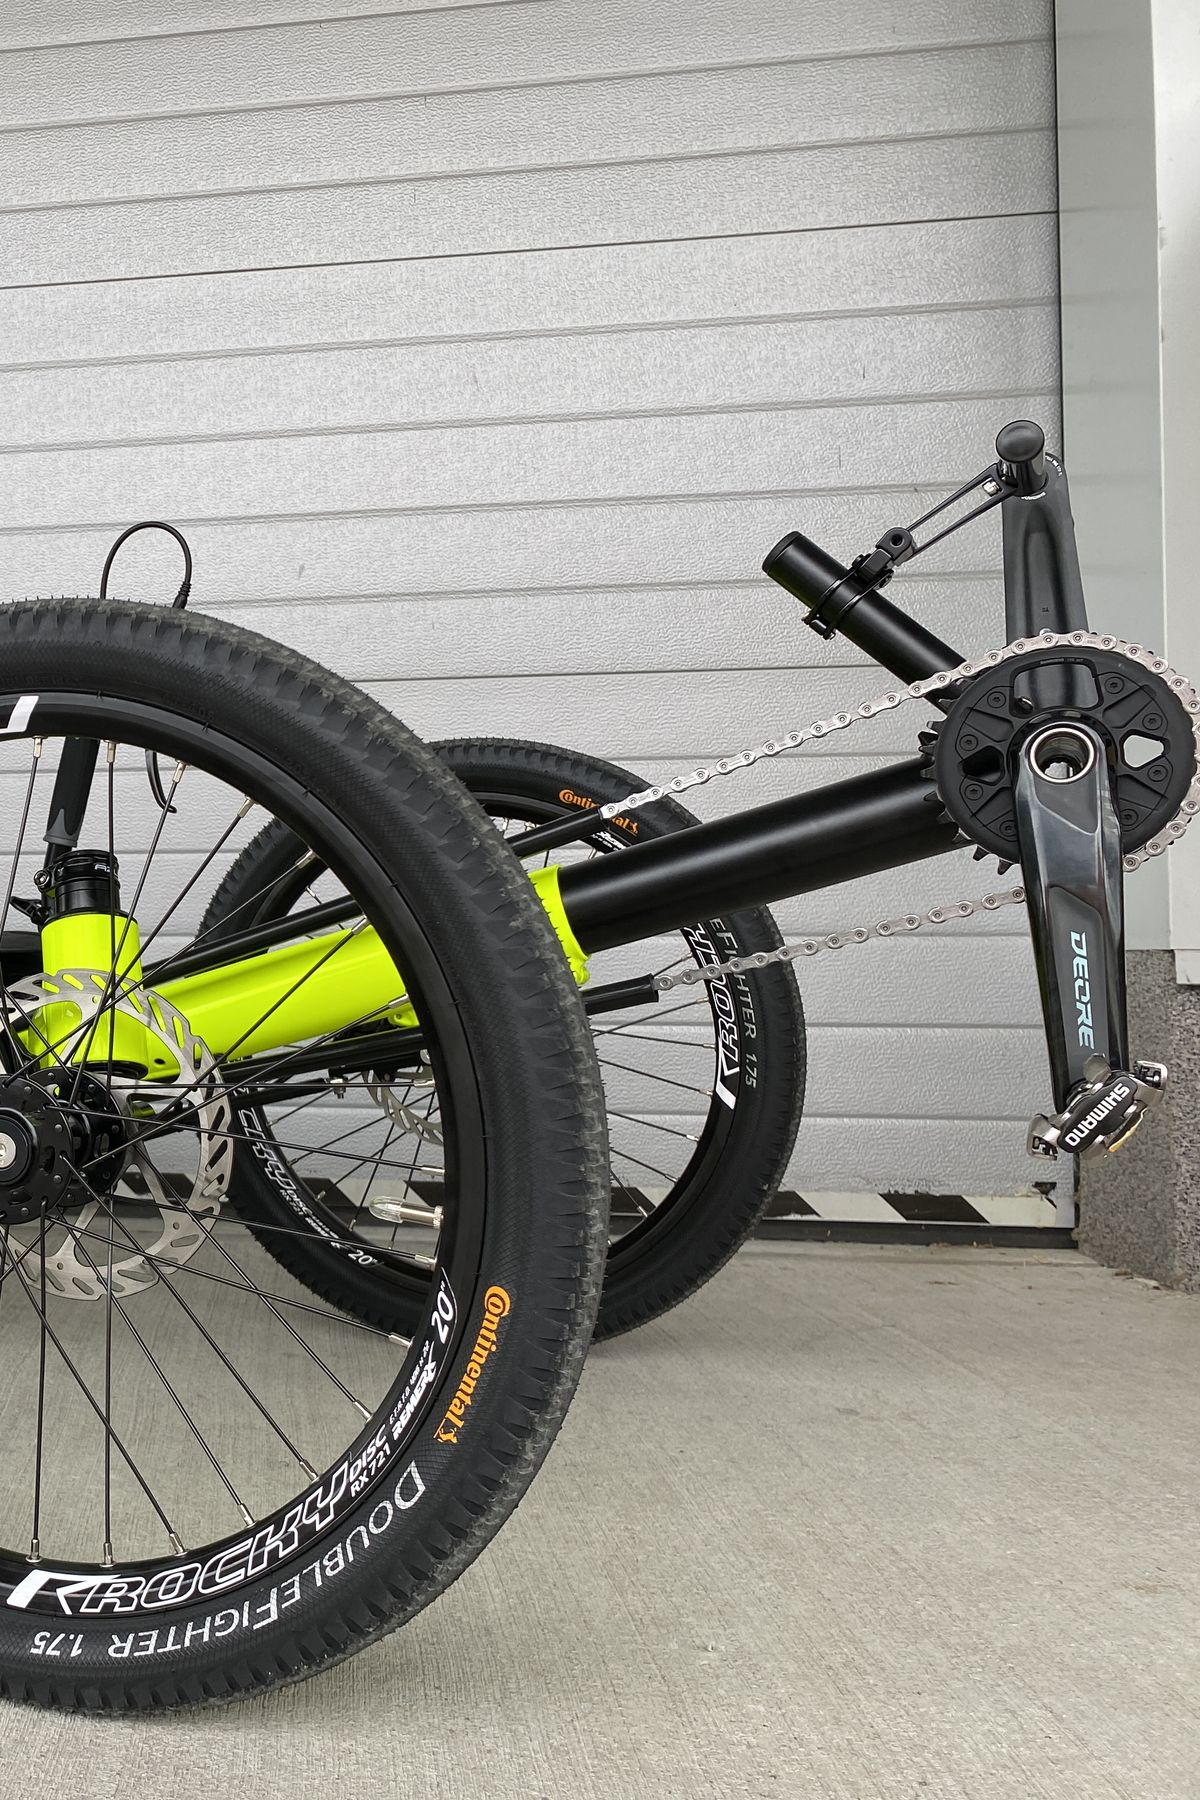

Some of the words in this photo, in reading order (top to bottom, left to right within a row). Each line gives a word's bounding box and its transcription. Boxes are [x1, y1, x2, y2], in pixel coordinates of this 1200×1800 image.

[1070, 930, 1095, 1050] DEORE
[745, 1052, 759, 1089] 1.75
[1065, 1083, 1131, 1147] SHIMANO
[443, 1286, 511, 1430] Continental
[349, 1424, 388, 1482] DISC
[350, 1471, 370, 1498] RX
[368, 1442, 392, 1476] 721
[79, 1460, 350, 1614] ROCKY
[107, 1460, 427, 1660] DOUBLEFIGHTER
[28, 1631, 85, 1657] 1.75
